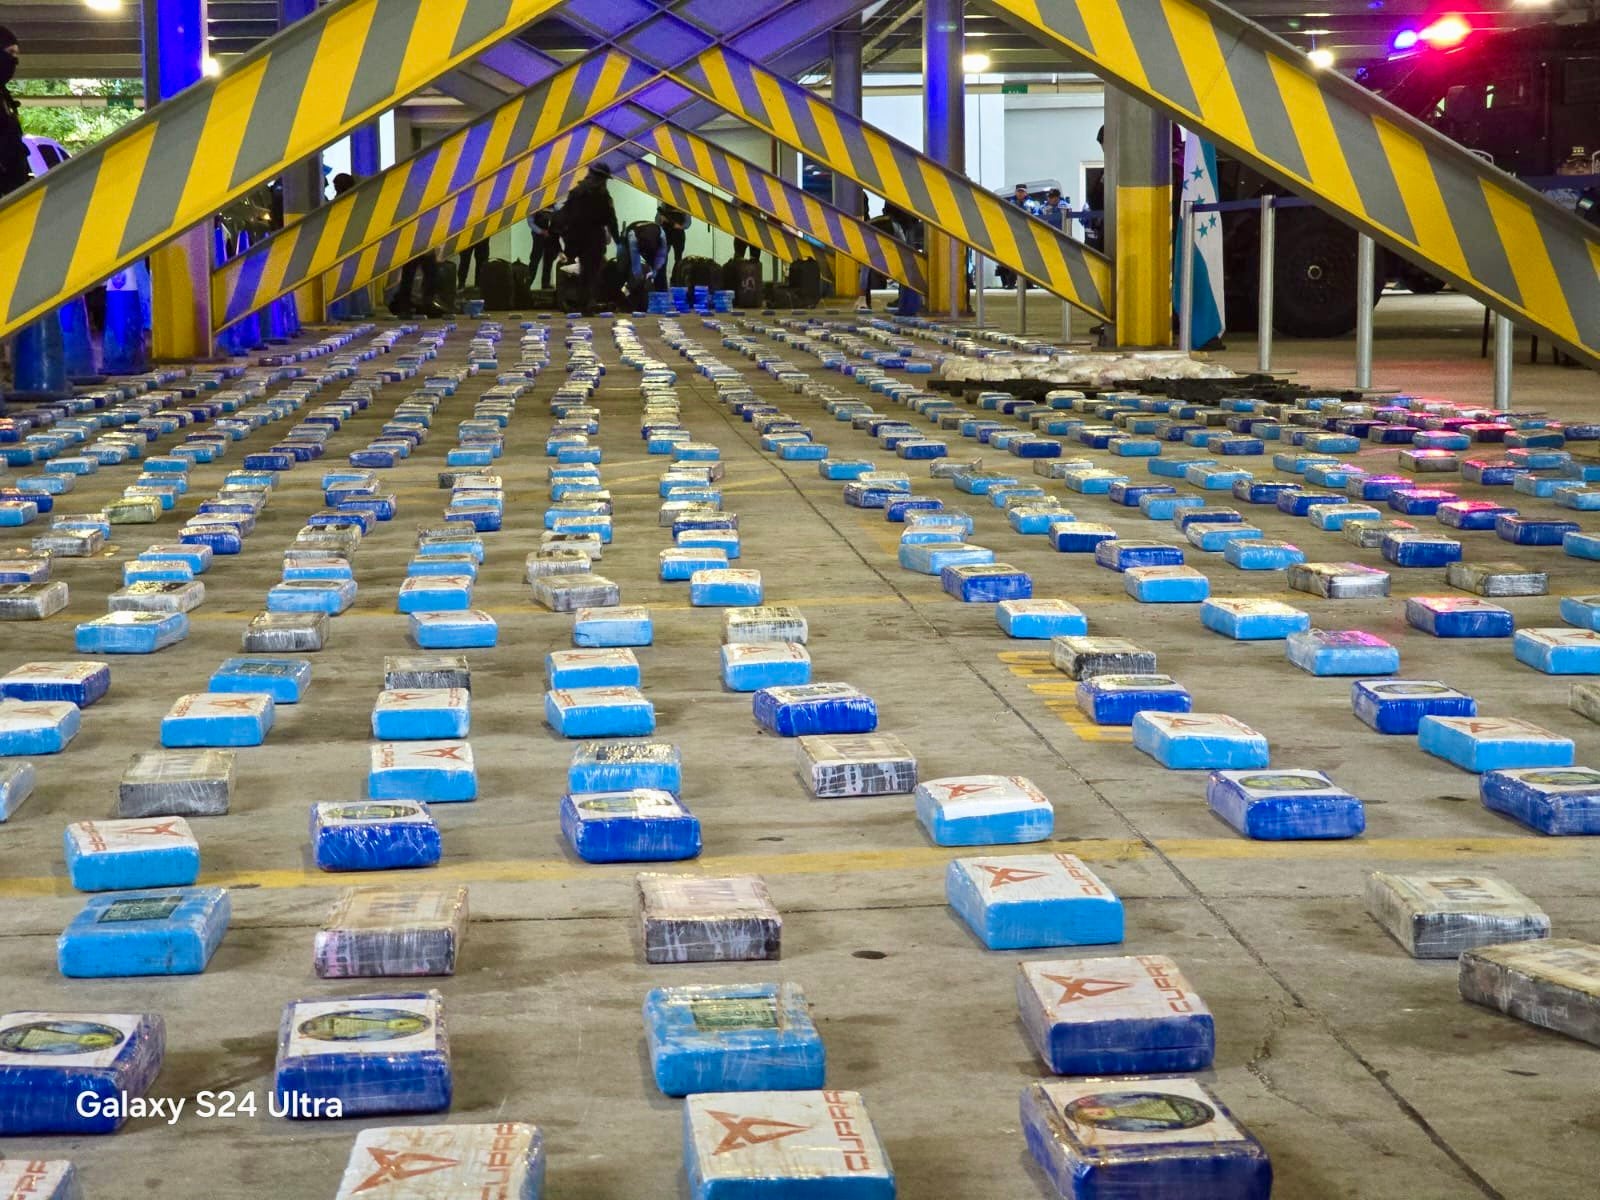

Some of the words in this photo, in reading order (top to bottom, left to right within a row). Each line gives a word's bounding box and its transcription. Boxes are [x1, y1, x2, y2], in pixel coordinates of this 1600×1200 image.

[1055, 853, 1102, 896] CUPRA
[1136, 956, 1193, 1013] CUPRA
[822, 1090, 872, 1172] CUPRA
